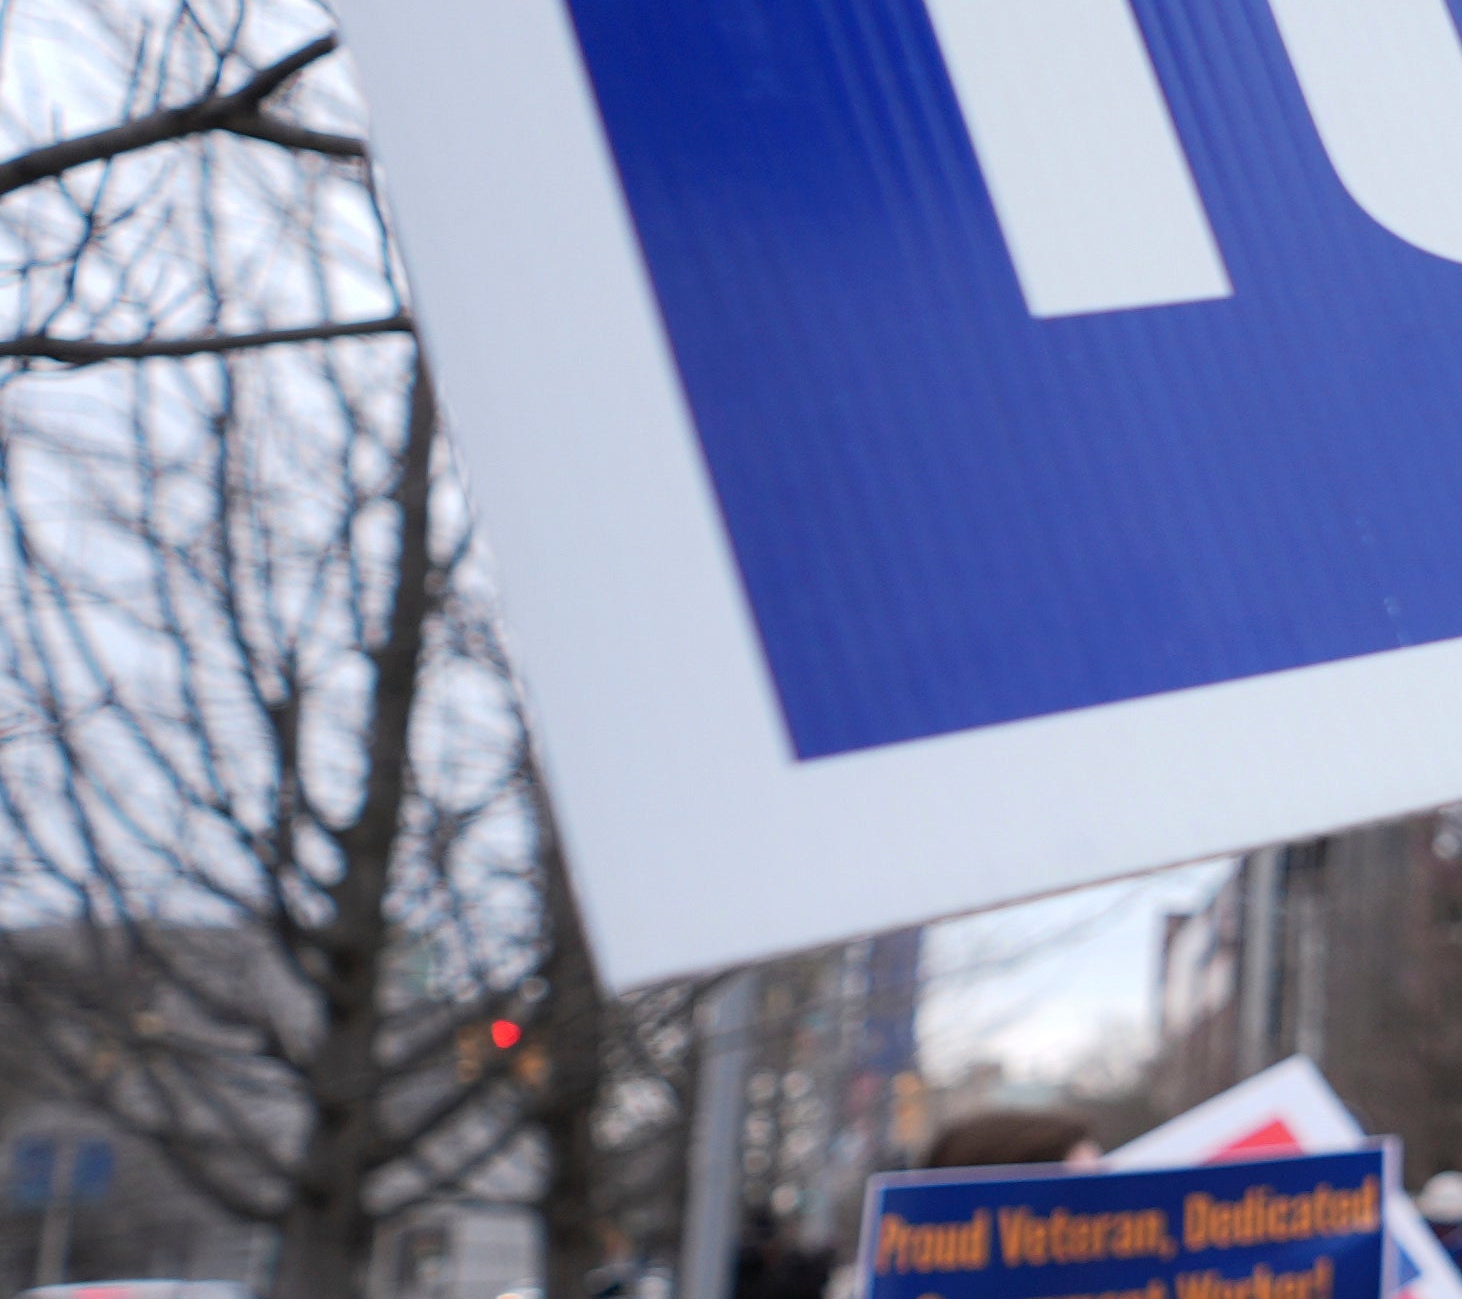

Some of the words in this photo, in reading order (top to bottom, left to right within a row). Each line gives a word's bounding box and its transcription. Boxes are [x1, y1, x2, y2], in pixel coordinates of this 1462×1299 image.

[875, 1208, 991, 1274] Proud
[998, 1204, 1177, 1269] Veteran,
[1182, 1174, 1382, 1252] Dedicated
